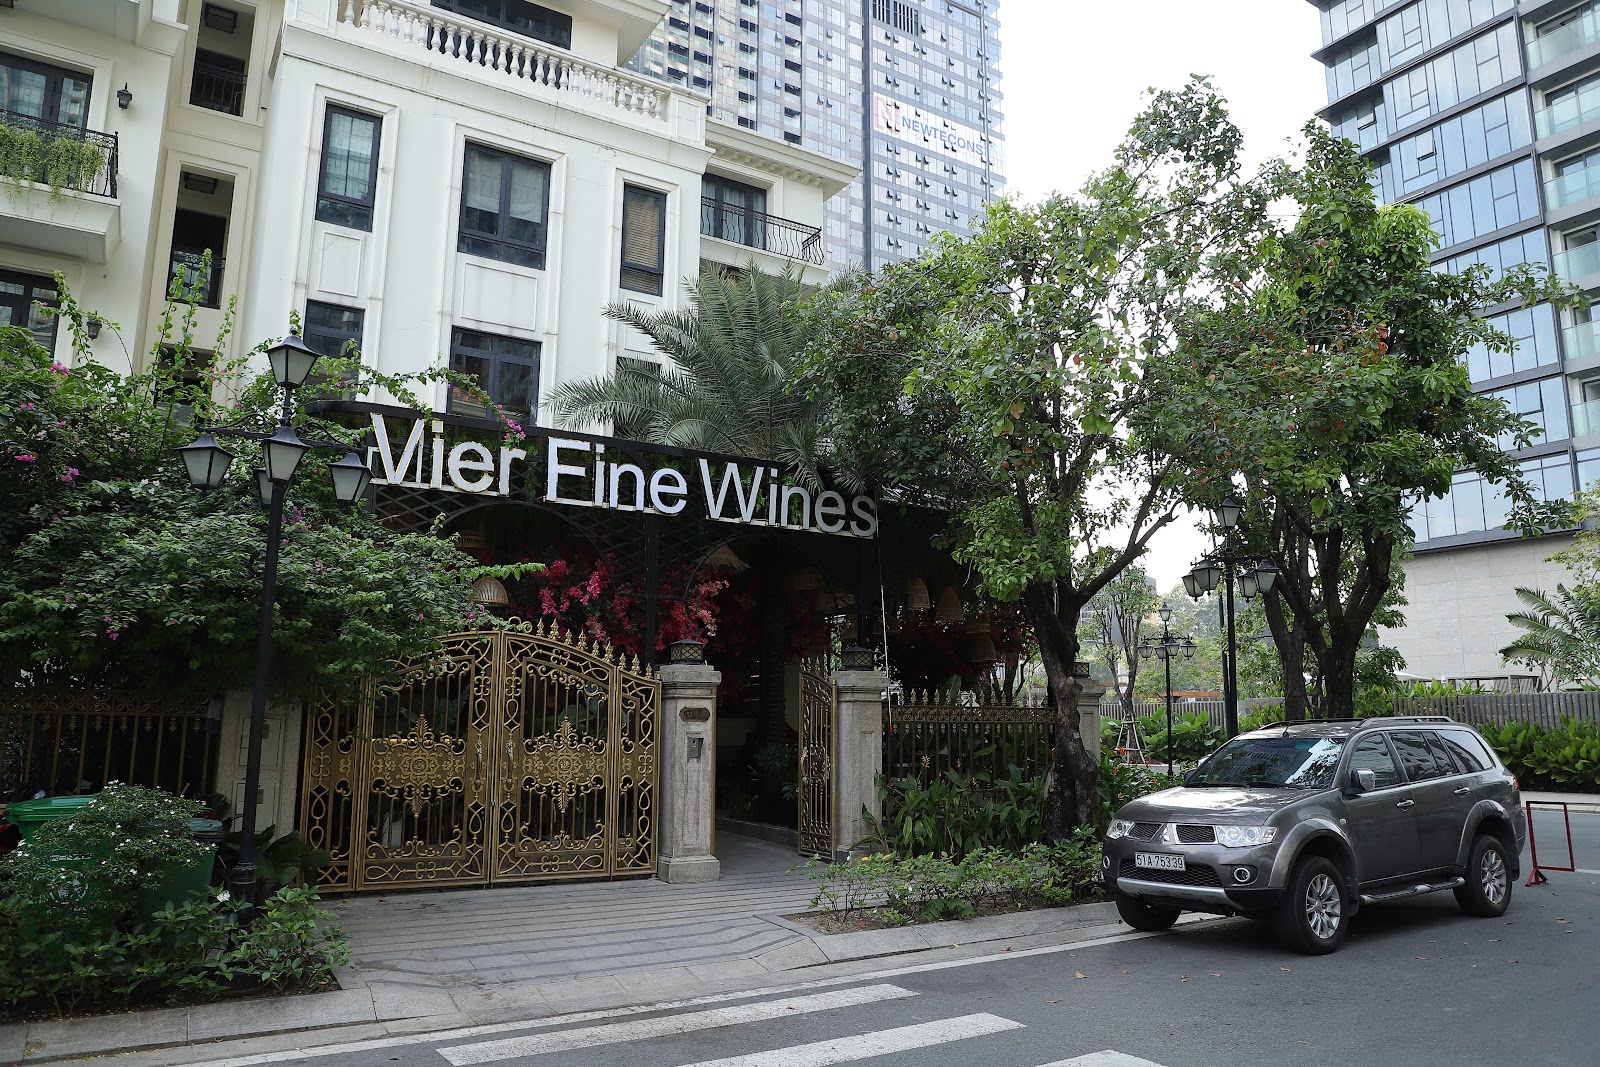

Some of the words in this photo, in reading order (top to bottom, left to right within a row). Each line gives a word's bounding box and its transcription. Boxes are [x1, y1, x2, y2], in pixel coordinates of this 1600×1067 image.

[902, 116, 983, 155] NEWTECONS
[369, 412, 526, 497] Vier
[546, 436, 688, 515] Fine
[699, 458, 877, 538] Wines
